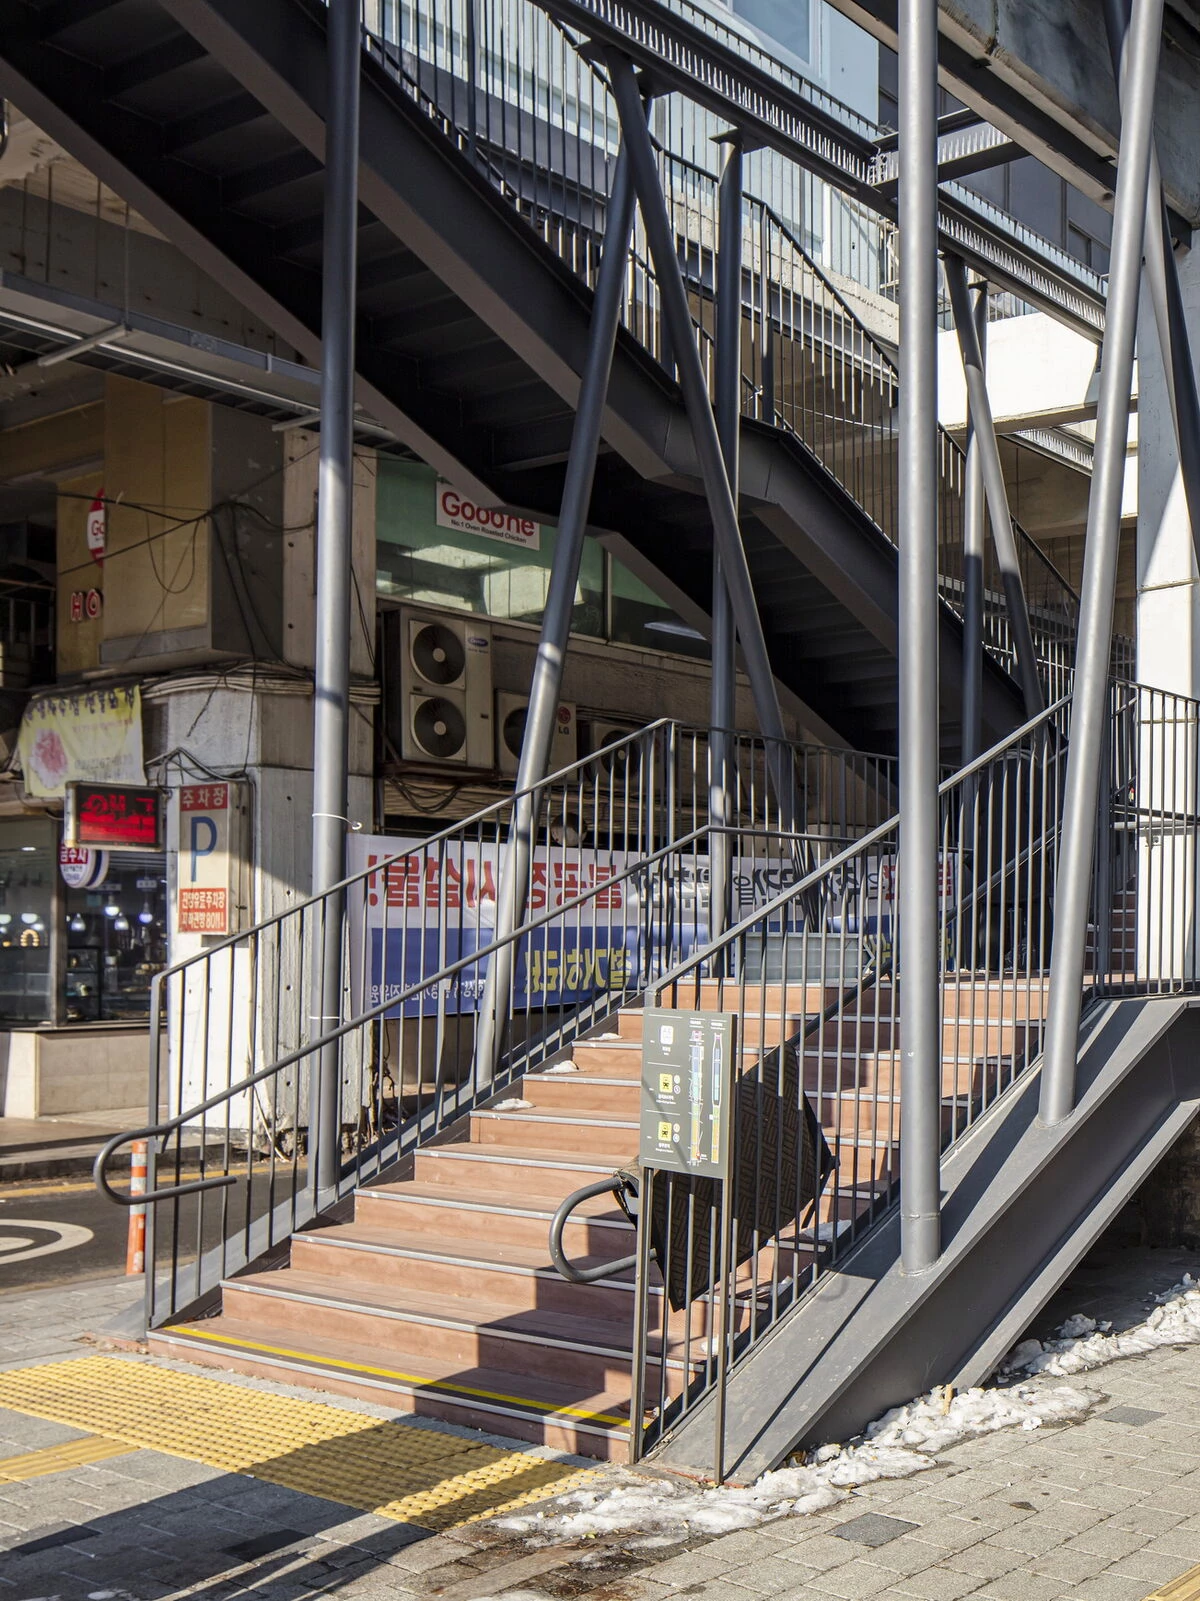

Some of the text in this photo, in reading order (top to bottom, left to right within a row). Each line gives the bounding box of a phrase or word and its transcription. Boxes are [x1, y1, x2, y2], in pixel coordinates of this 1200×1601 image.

[465, 522, 480, 532] Oven
[481, 526, 504, 539] Roasted
[504, 531, 528, 544] Chicken
[558, 726, 570, 735] LG
[182, 786, 226, 809] 주차장
[191, 815, 218, 882] P
